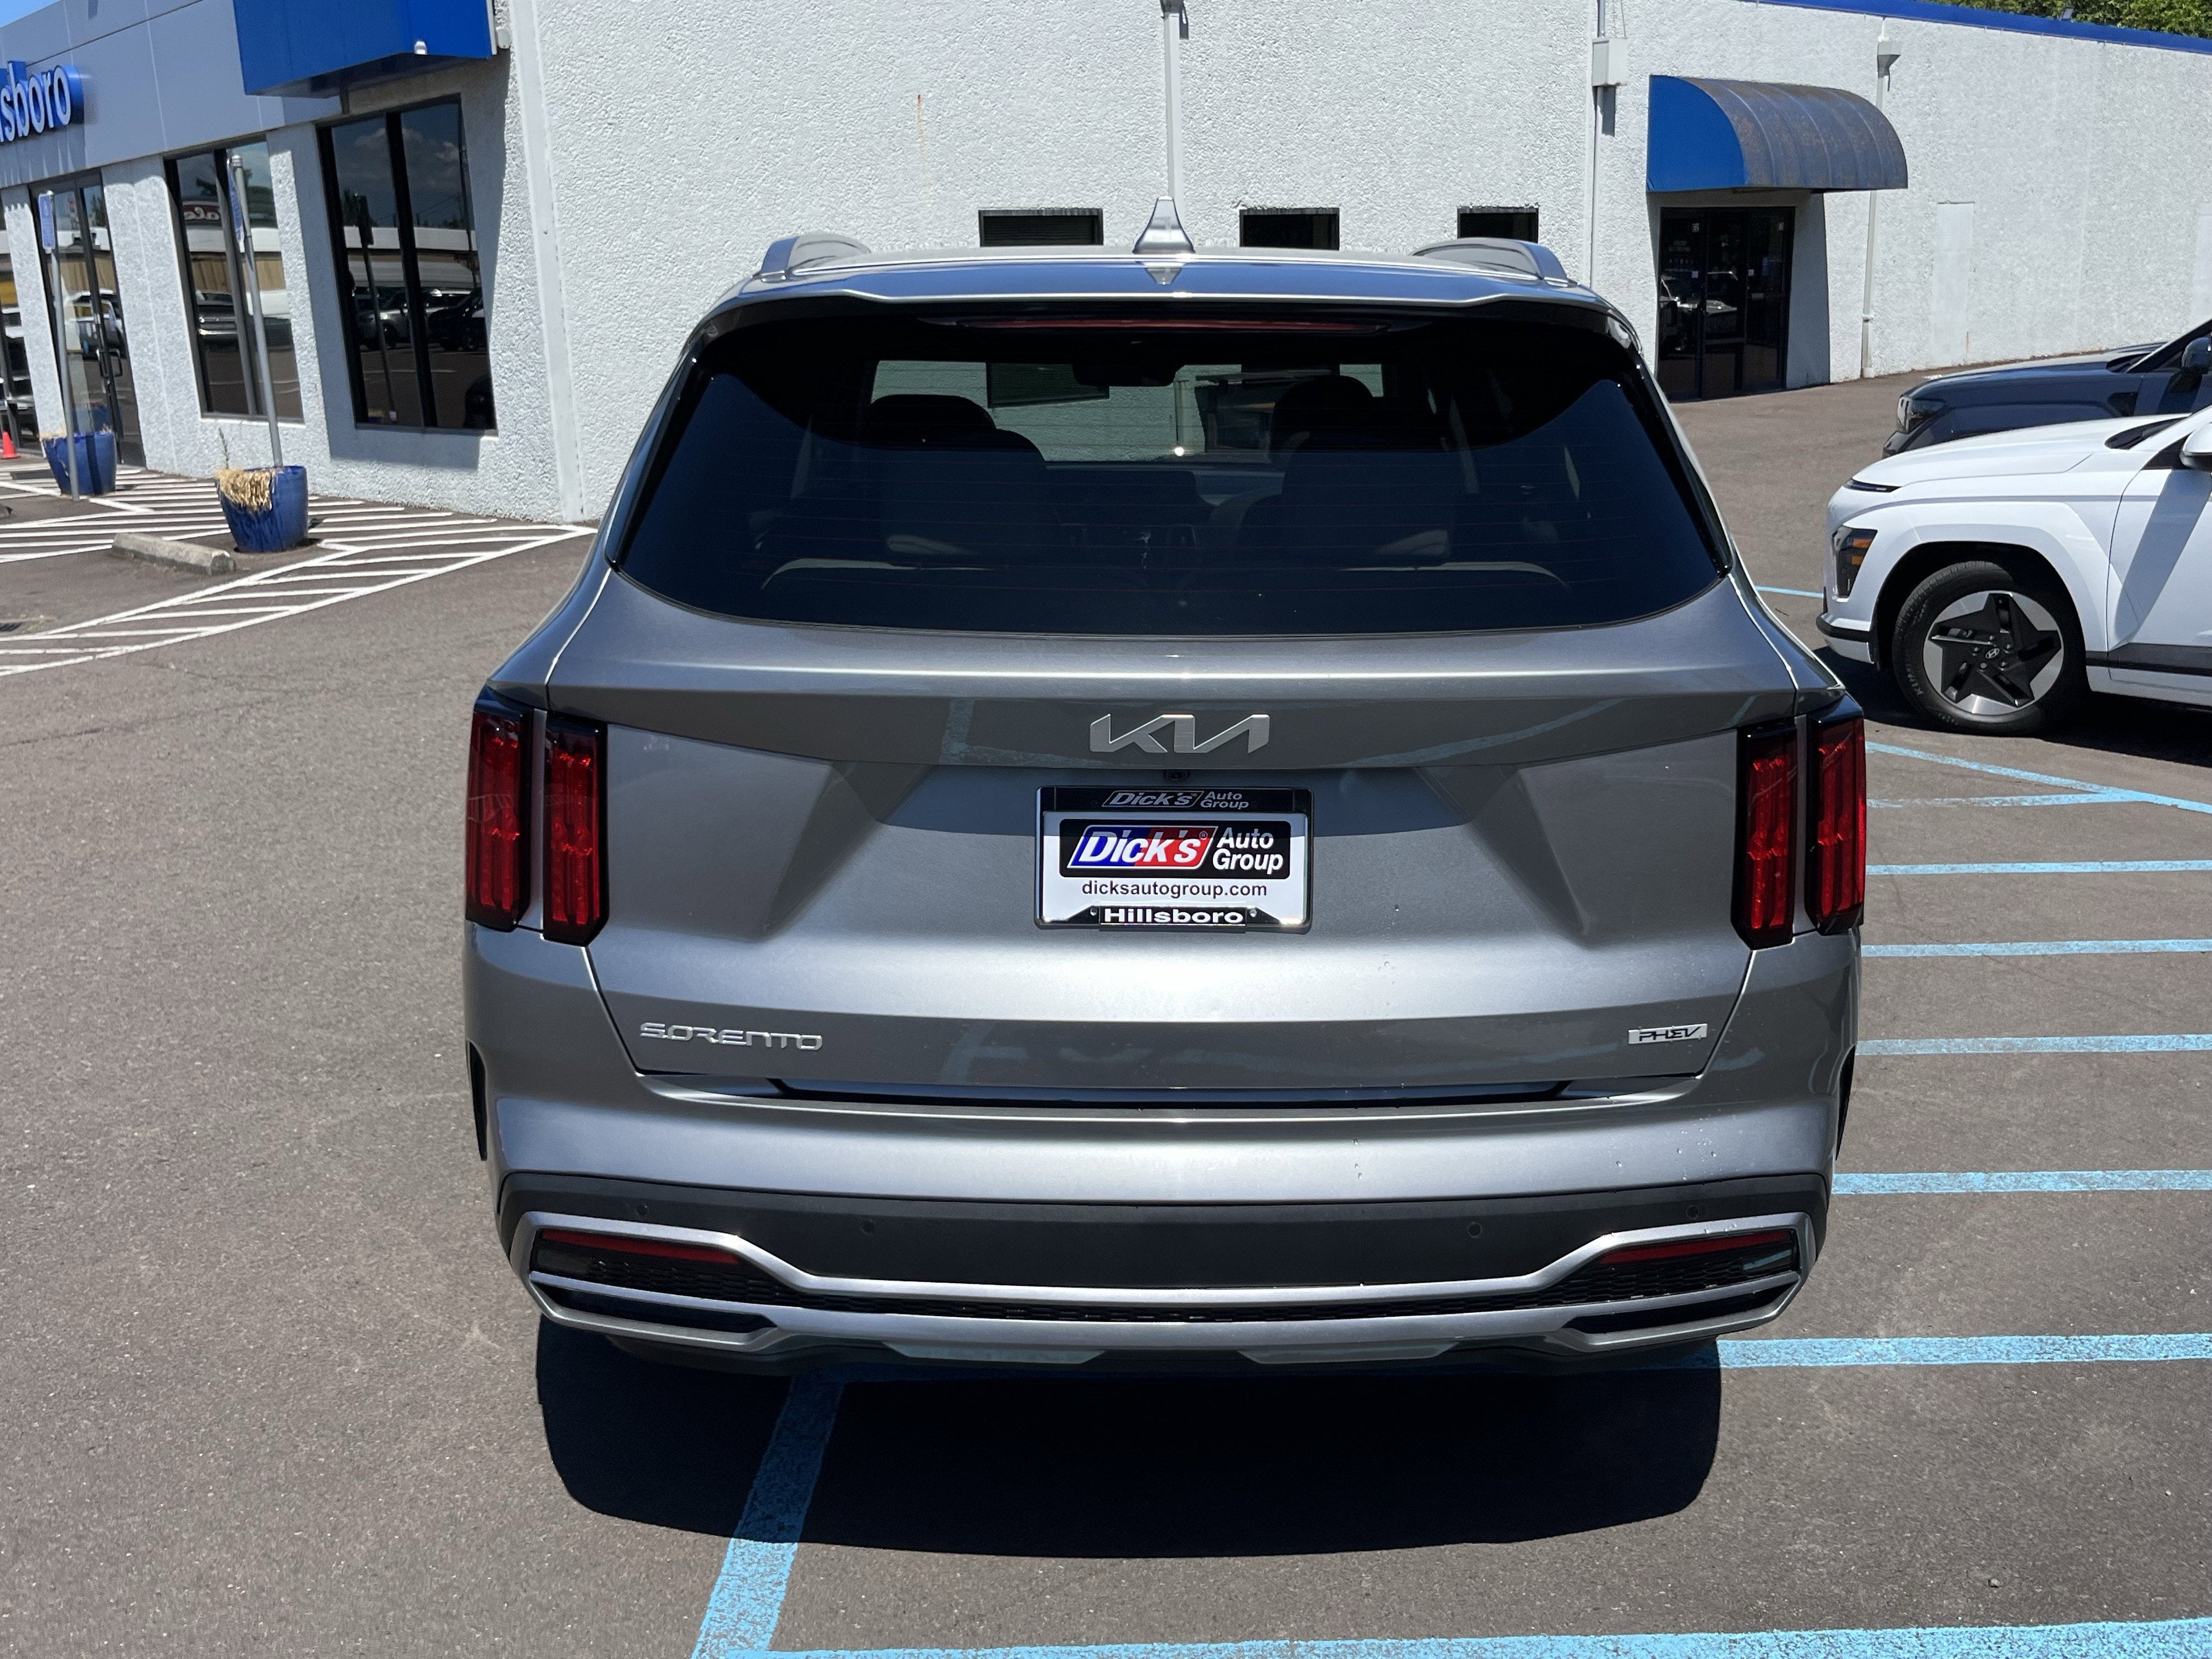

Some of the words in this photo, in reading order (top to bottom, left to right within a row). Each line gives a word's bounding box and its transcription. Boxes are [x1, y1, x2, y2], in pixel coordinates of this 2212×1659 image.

[0, 61, 72, 143] sboro
[1090, 714, 1270, 753] KIA
[1200, 799, 1249, 810] Group
[1205, 791, 1243, 800] Auto
[1216, 827, 1274, 849] Auto
[1212, 848, 1284, 875] Group
[1082, 880, 1267, 899] dicksautogroup.com
[1104, 908, 1244, 923] Hillsboro
[640, 1022, 823, 1051] SORENTO
[1639, 1026, 1701, 1042] PHEV
